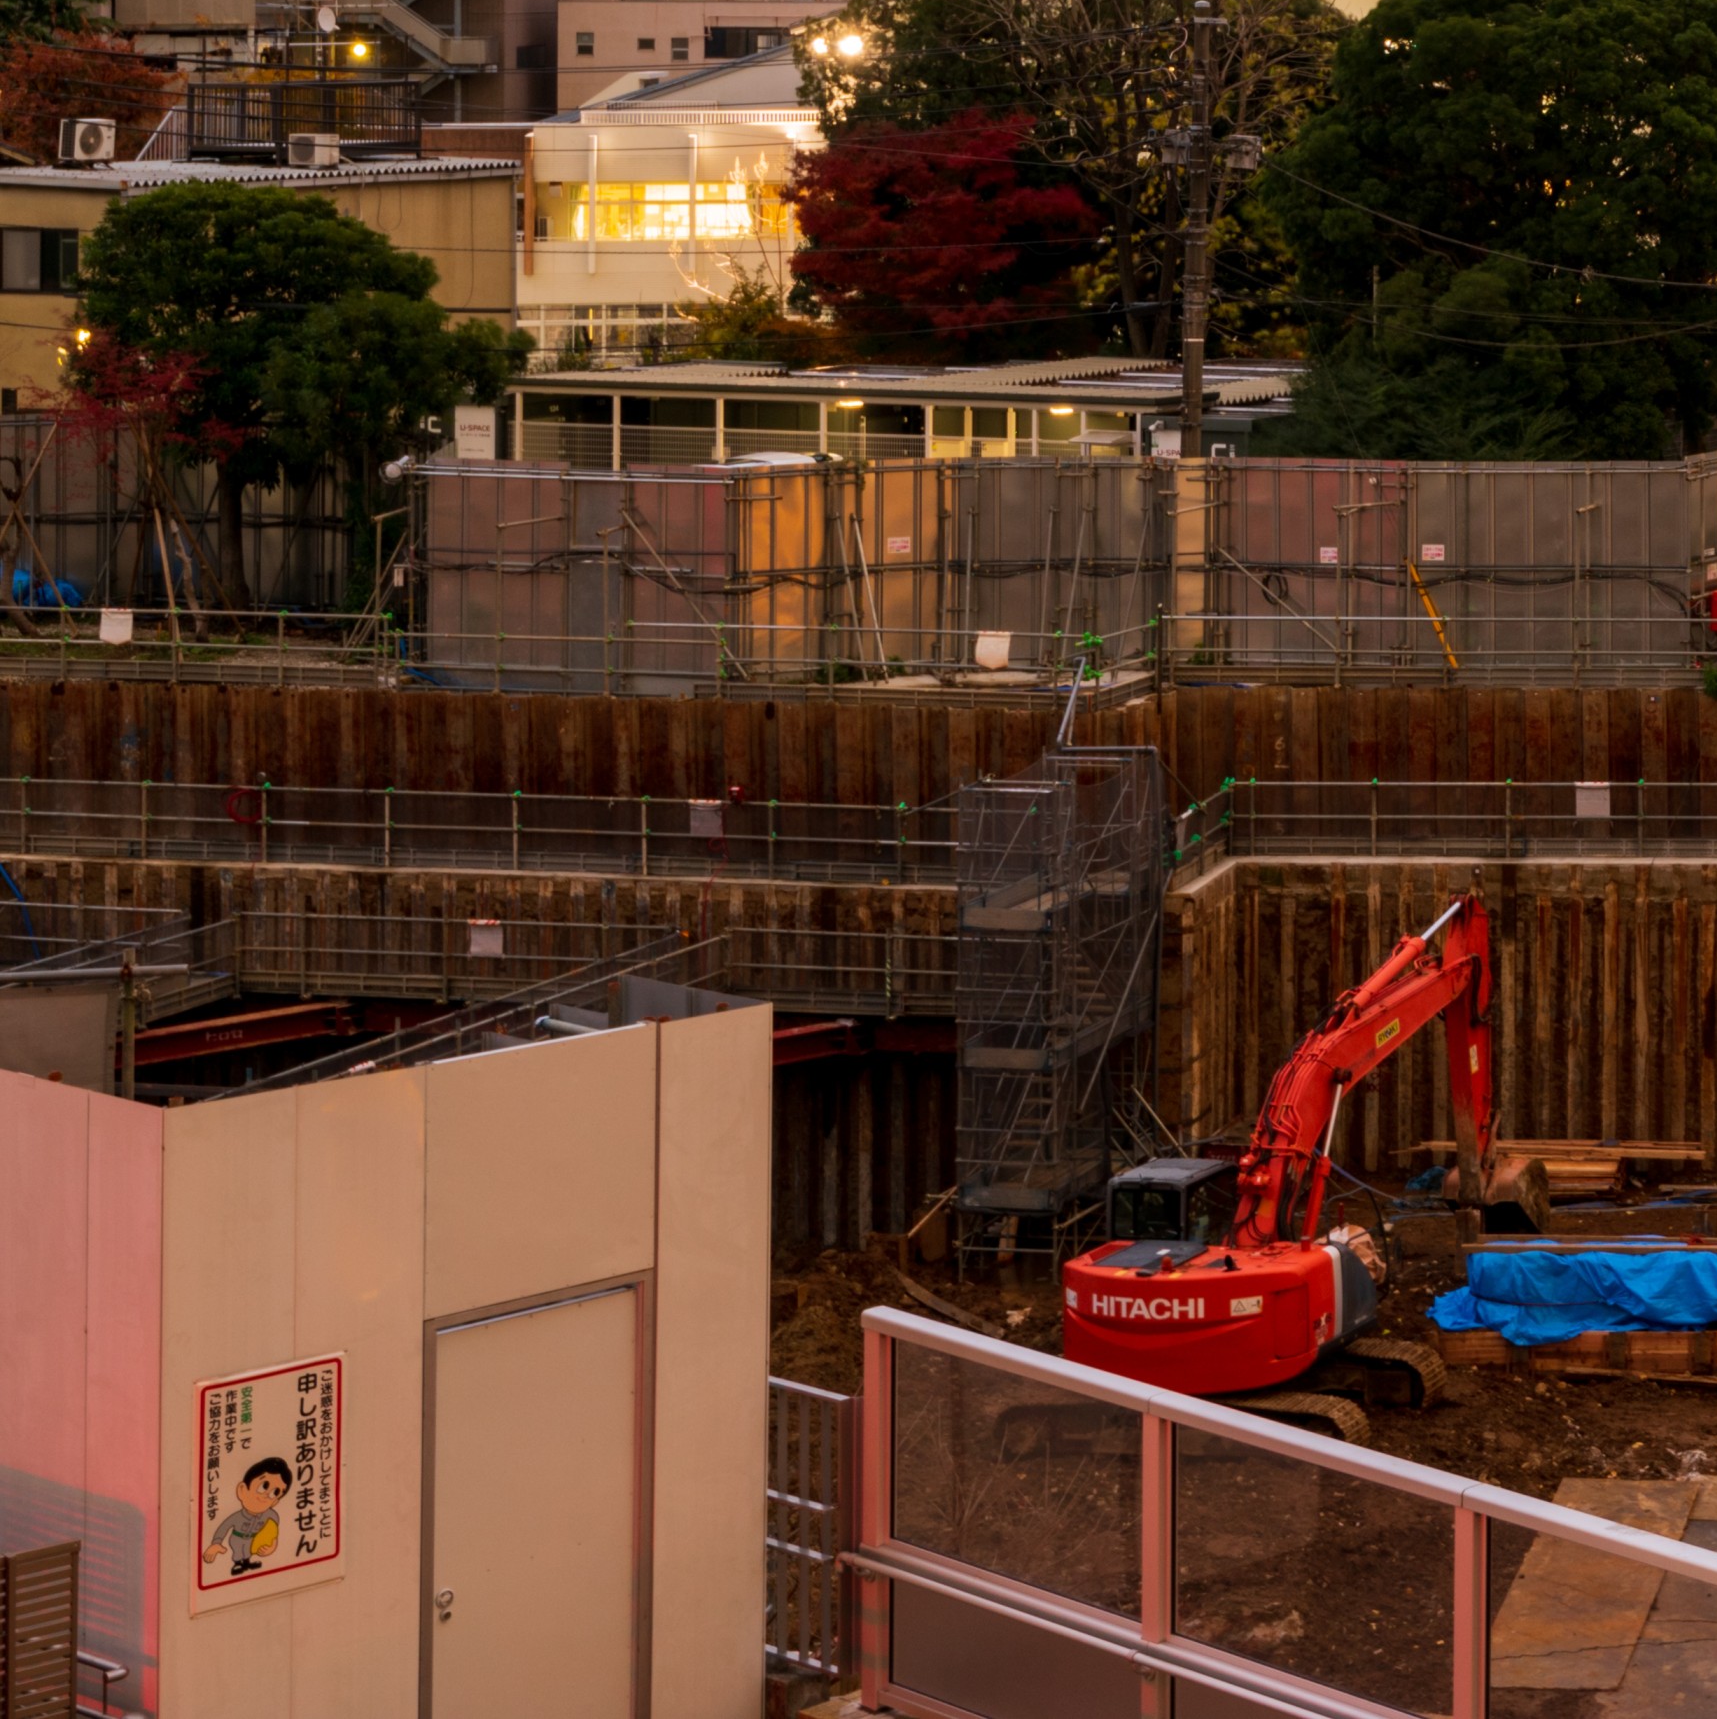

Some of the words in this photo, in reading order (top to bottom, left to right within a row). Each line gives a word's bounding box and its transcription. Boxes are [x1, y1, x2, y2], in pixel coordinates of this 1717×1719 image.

[1091, 1293, 1206, 1321] HITACHI
[206, 1392, 222, 1522] ご協力をお願いします
[223, 1389, 238, 1454] 作業中です
[240, 1385, 253, 1450] 安全第一で
[294, 1372, 318, 1558] 申し訳ありません
[318, 1368, 333, 1539] ご迷惑をおかけしてまことに
